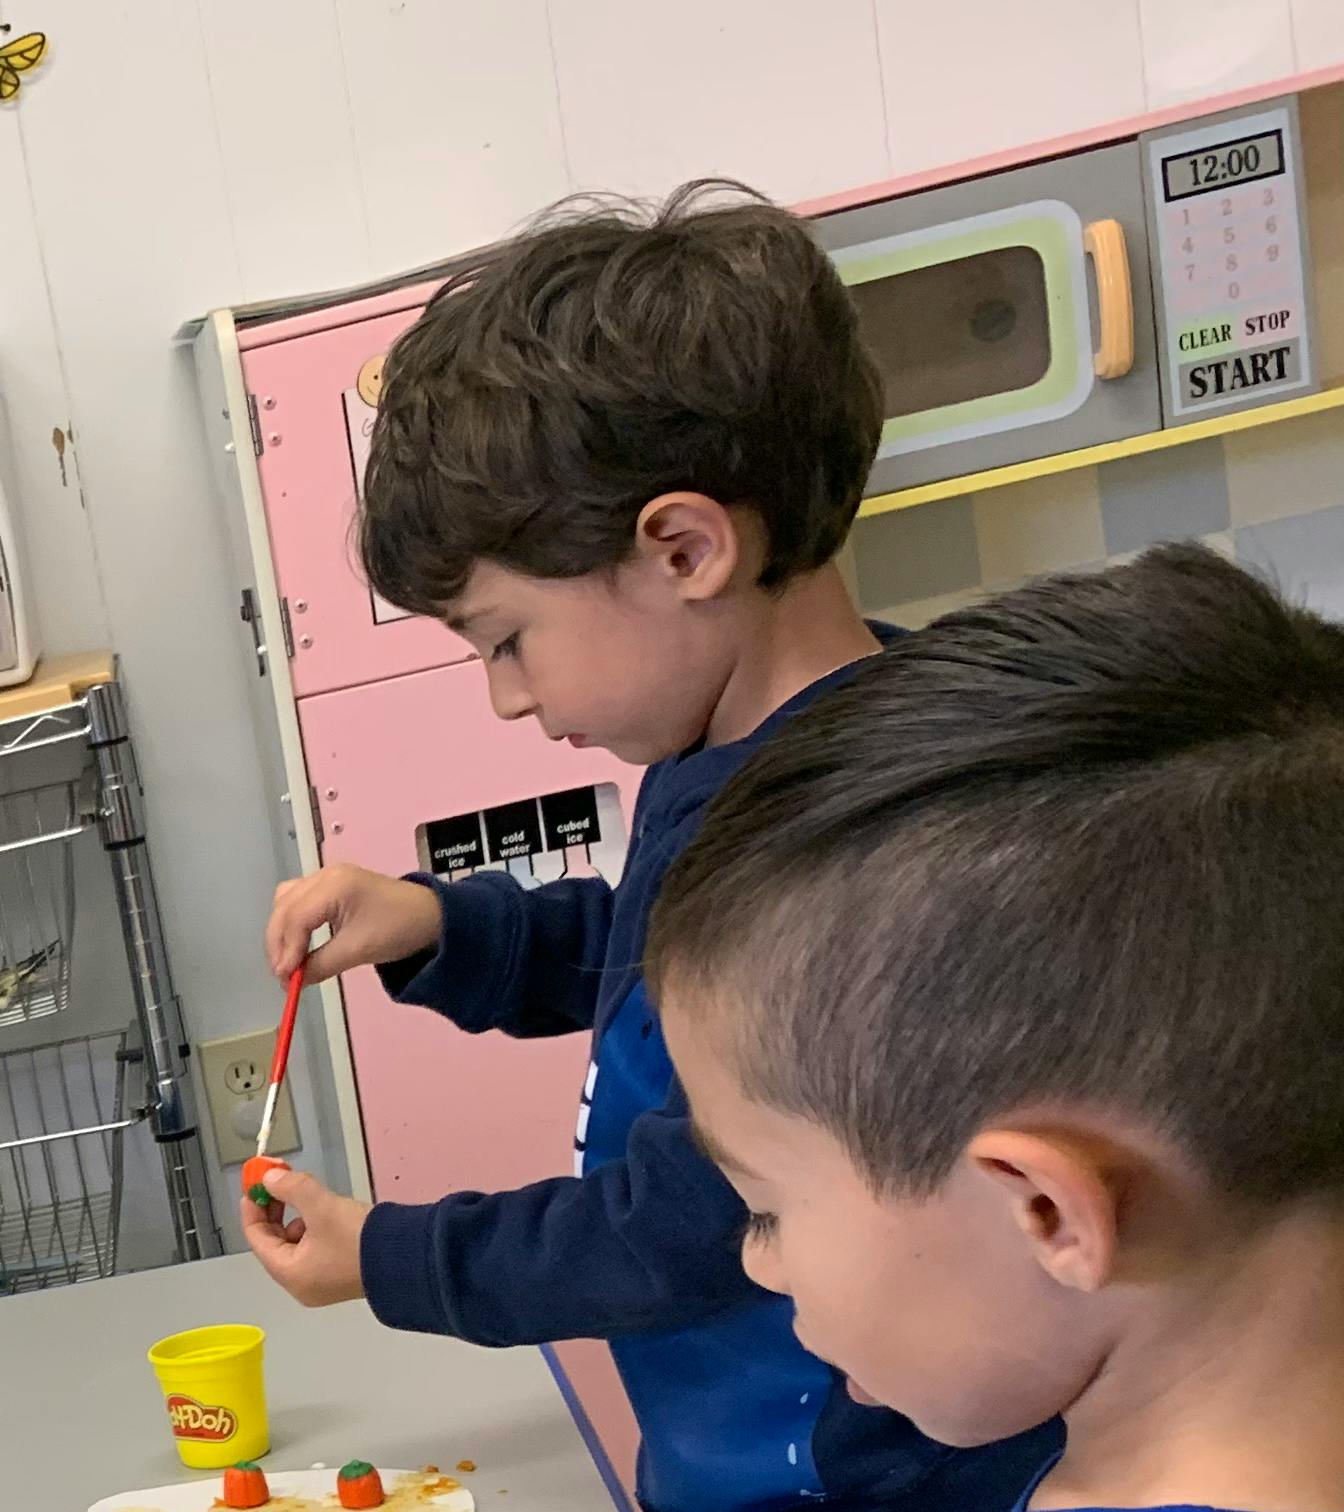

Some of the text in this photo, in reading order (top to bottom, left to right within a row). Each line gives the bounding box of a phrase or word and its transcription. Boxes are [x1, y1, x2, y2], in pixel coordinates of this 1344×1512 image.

[1189, 144, 1261, 187] 12:00
[1182, 187, 1275, 226] 1 2 3
[1181, 215, 1277, 254] 4 5 6
[1184, 243, 1279, 281] 7 8 9
[1228, 281, 1240, 300] 0
[1178, 309, 1291, 352] CLEAR STOP
[1188, 346, 1291, 399] START
[556, 817, 590, 834] cubed
[501, 830, 525, 846] cold
[566, 833, 584, 845] ice
[434, 840, 477, 860] crushed
[499, 843, 531, 858] water
[448, 857, 465, 869] ice
